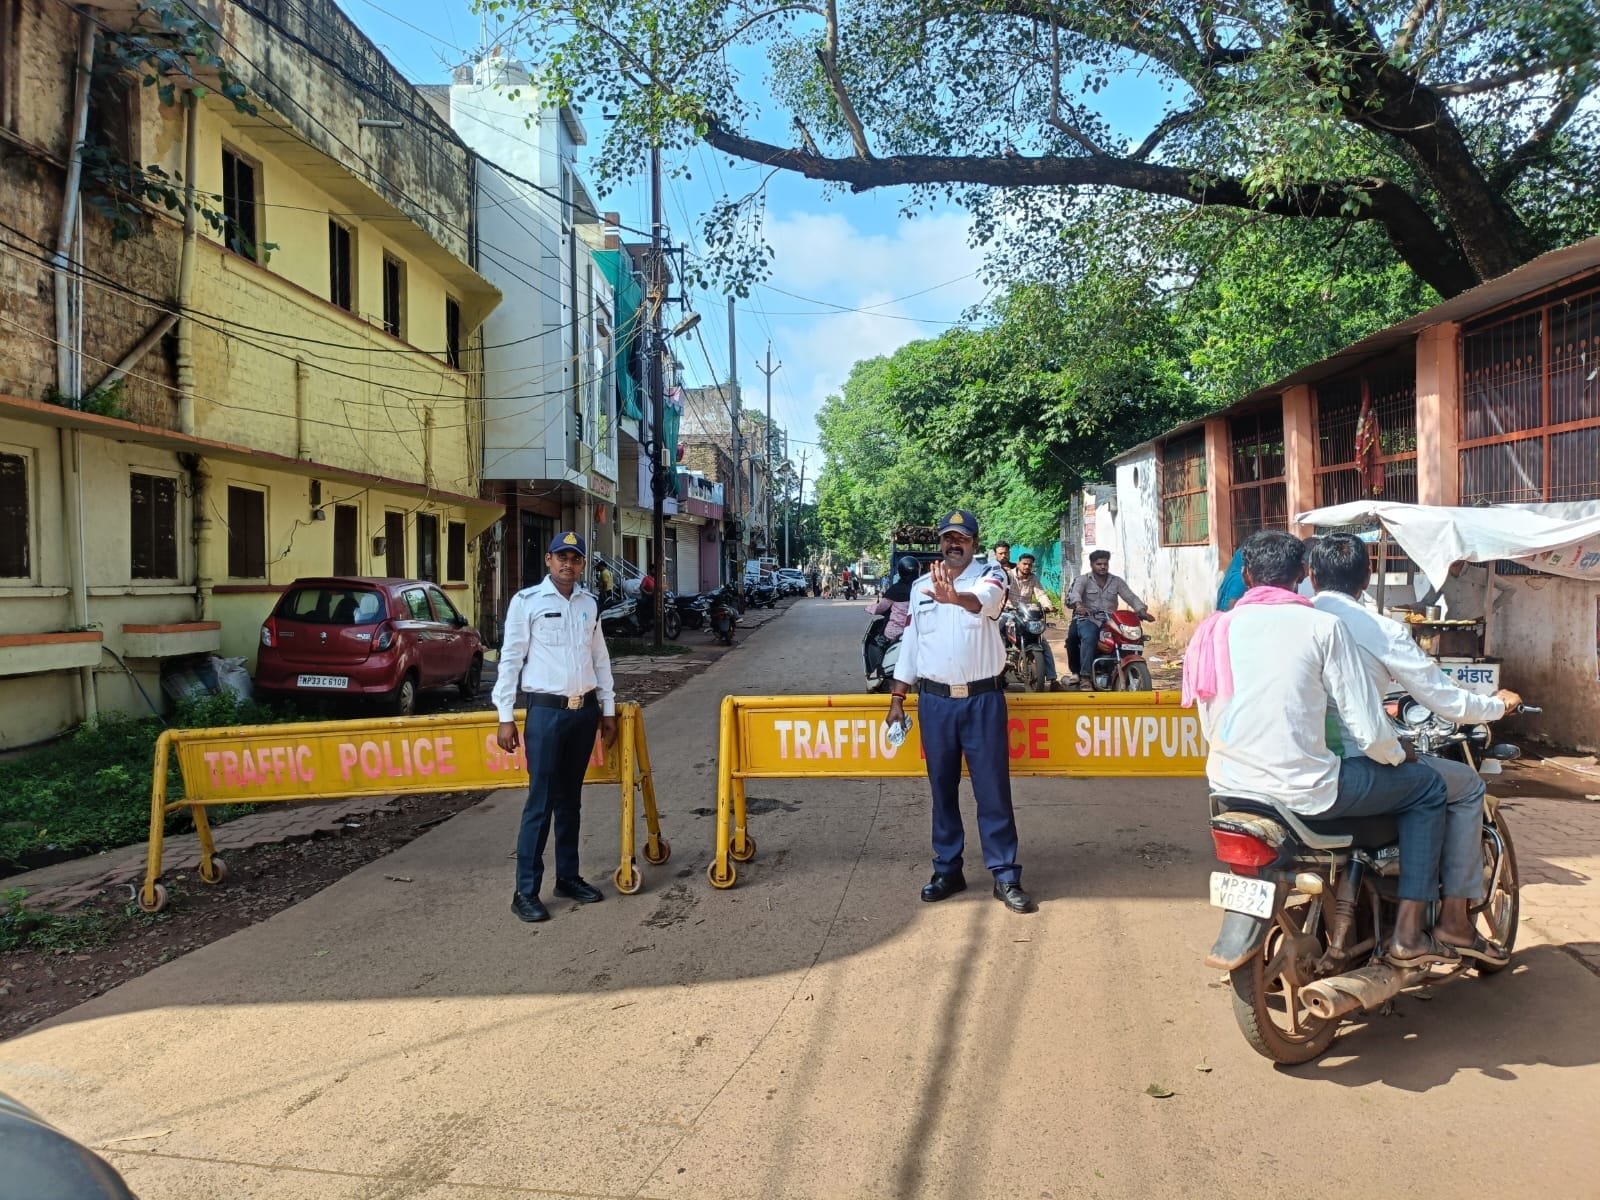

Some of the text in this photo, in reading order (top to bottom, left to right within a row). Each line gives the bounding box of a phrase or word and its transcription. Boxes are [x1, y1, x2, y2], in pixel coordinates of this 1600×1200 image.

[1457, 665, 1494, 684] भंडार
[203, 744, 315, 789] TRAFFIC
[338, 735, 457, 781] POLICE
